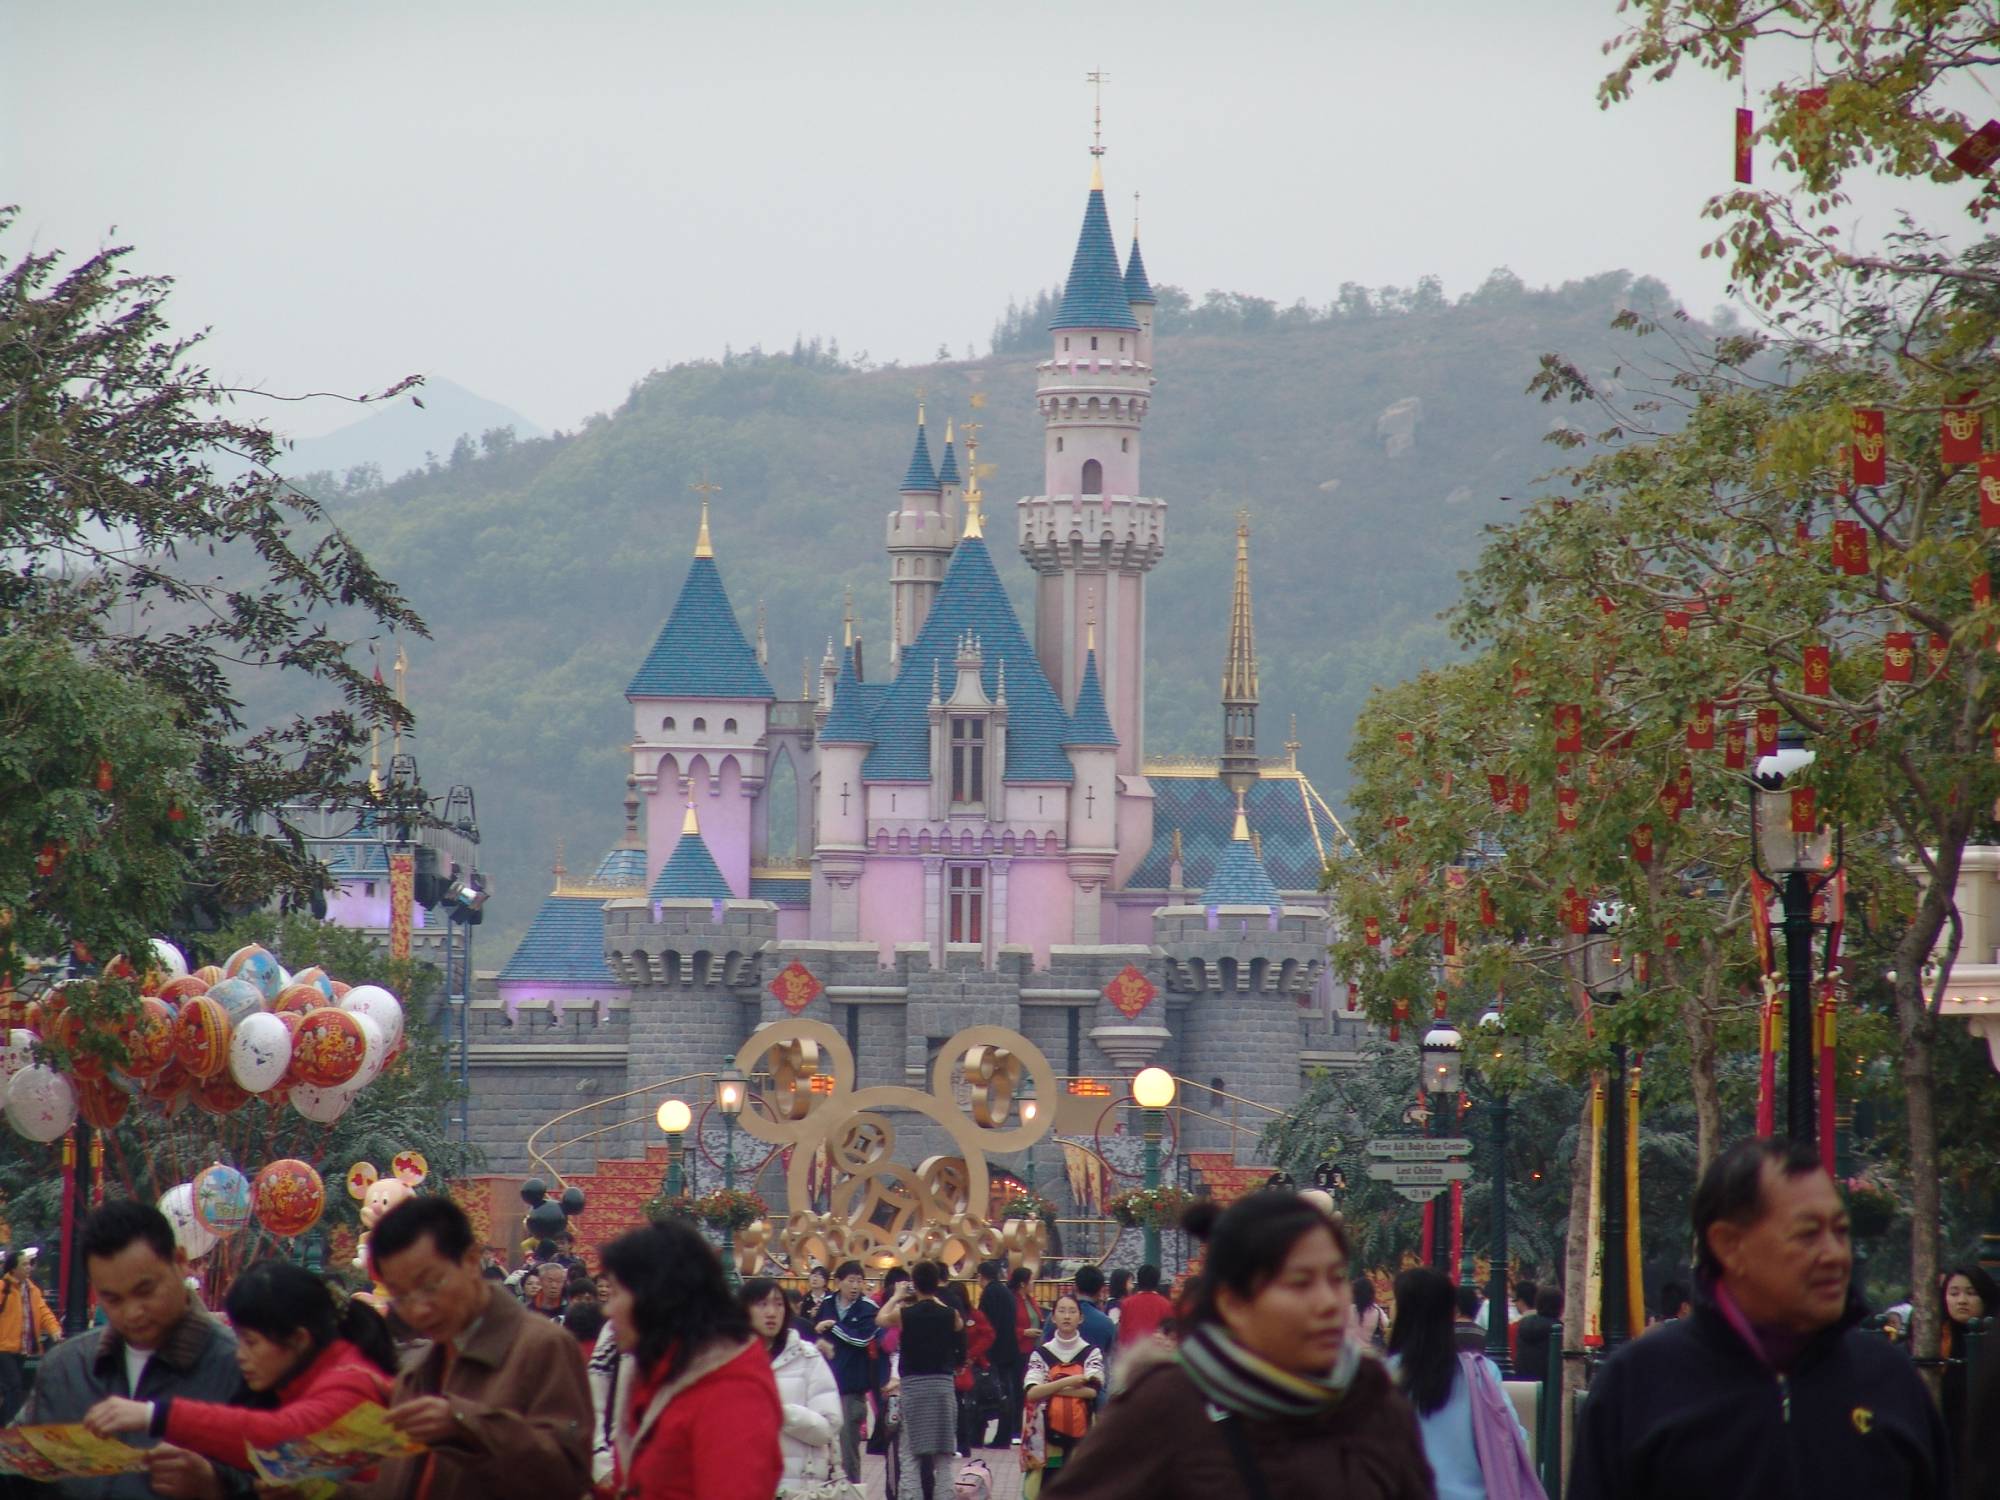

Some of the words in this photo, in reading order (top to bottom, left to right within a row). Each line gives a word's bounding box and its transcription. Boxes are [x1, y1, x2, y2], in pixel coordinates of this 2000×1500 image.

[1408, 1142, 1424, 1152] Baby
[1426, 1142, 1441, 1151] Care
[1396, 1166, 1411, 1175] Lost
[1413, 1166, 1442, 1175] Children
